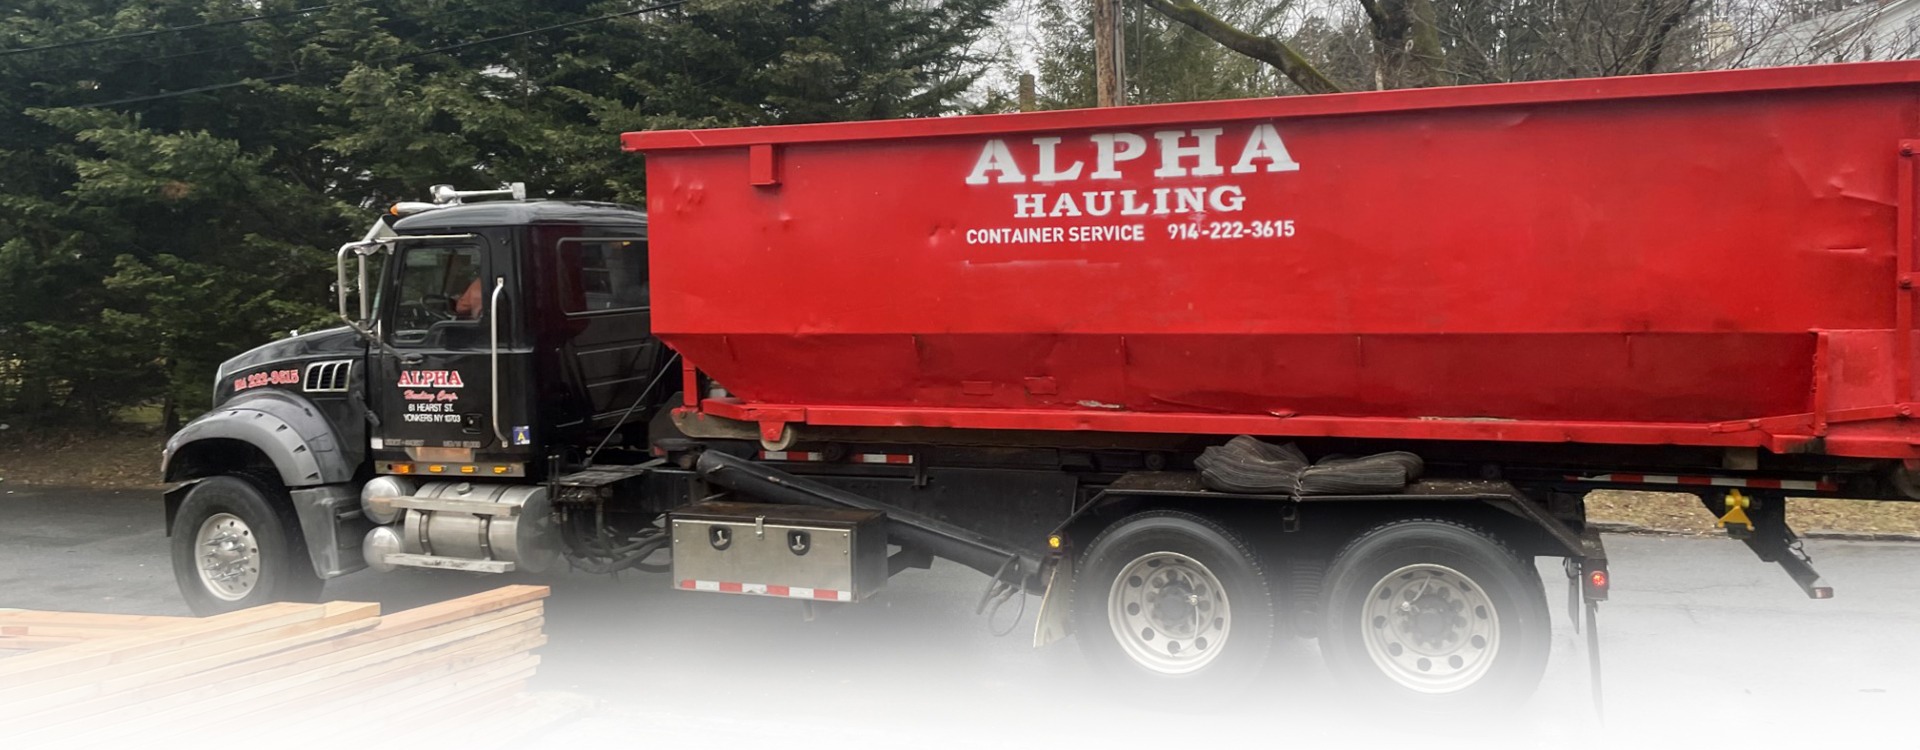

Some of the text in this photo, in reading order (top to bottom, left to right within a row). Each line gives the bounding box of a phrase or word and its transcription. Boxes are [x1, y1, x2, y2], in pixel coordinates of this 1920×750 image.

[965, 123, 1300, 185] ALPHA
[1013, 186, 1246, 218] HAULING
[966, 220, 1295, 245] CONTAINER SERVICE 914-222-3615
[397, 370, 464, 388] ALPHA
[402, 413, 433, 423] YONKERS
[433, 414, 444, 423] NY
[416, 403, 442, 413] HEARST
